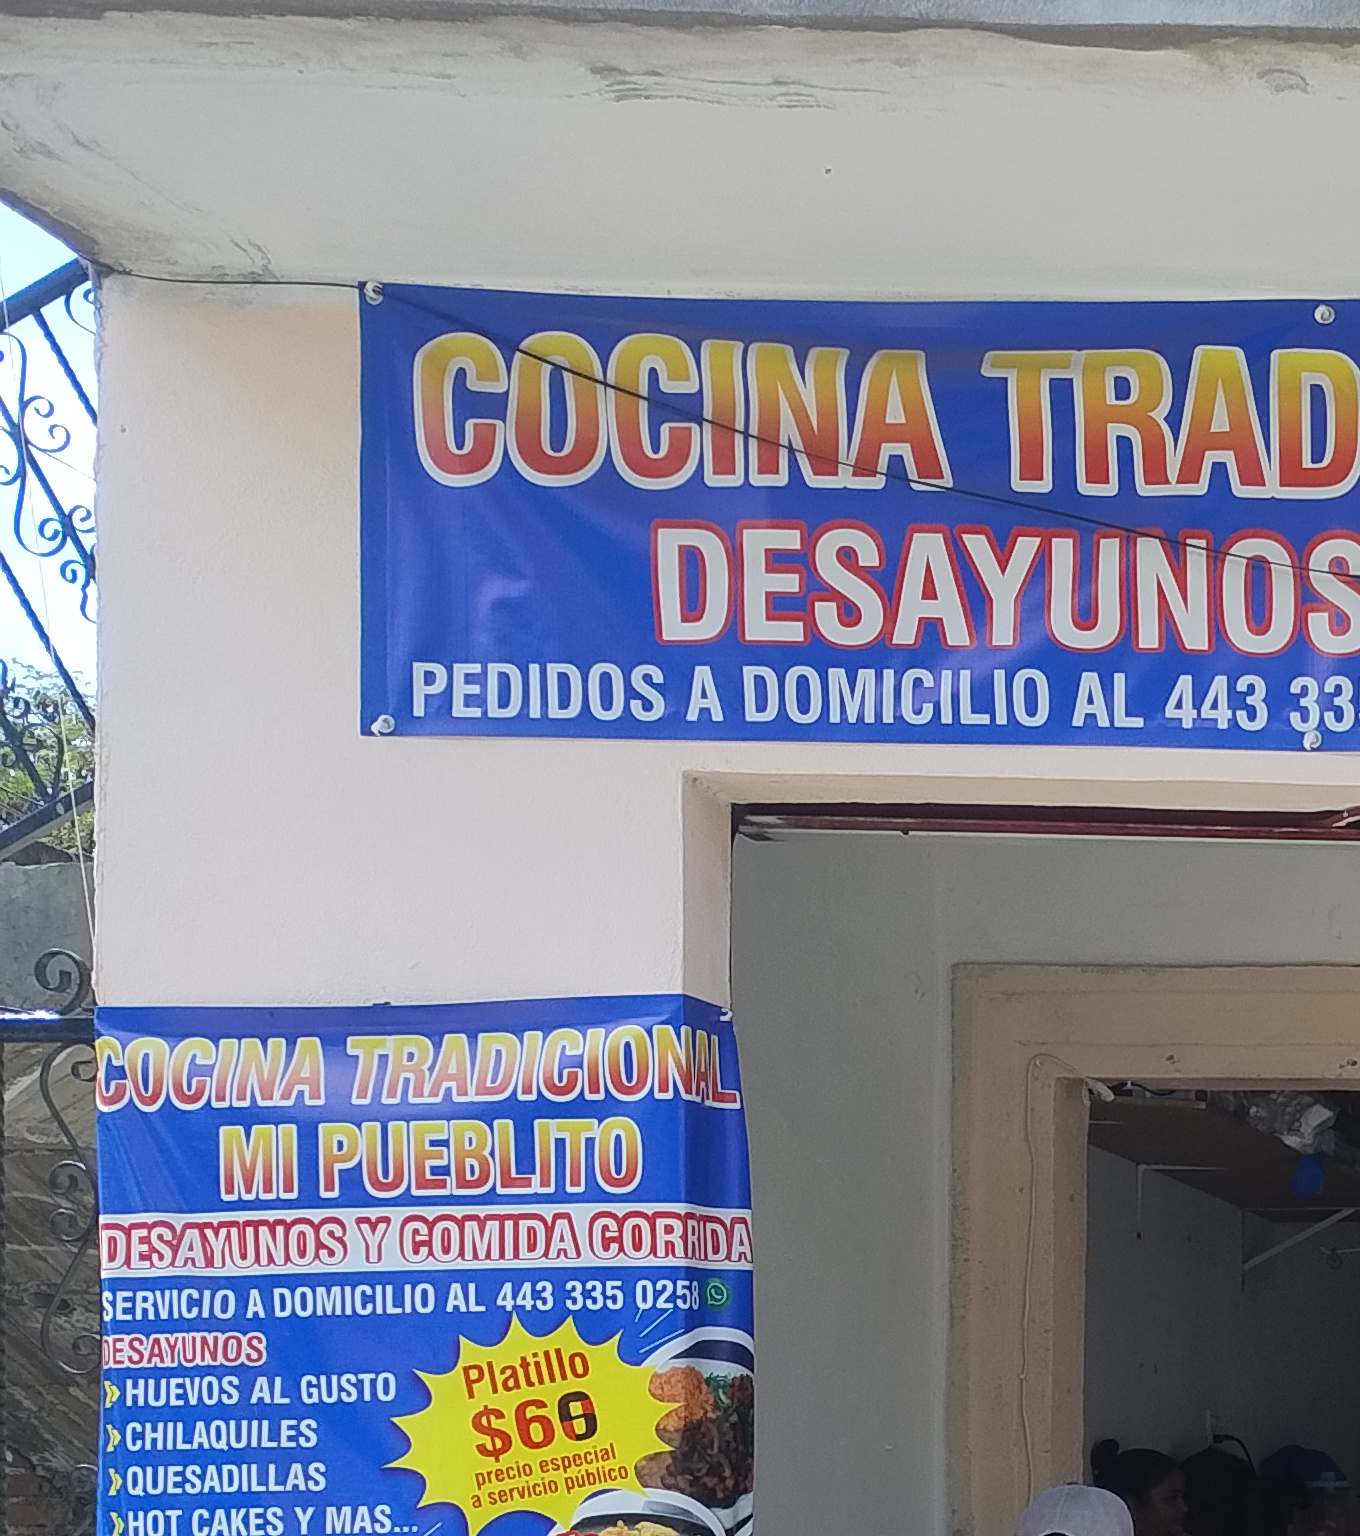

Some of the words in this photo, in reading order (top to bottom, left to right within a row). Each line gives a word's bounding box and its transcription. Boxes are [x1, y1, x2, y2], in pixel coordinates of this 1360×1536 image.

[414, 331, 953, 488] COCINA
[413, 662, 664, 721] PEDIDOS
[686, 666, 723, 721] A
[746, 666, 1049, 726] DOMICILIO
[1072, 672, 1144, 727] AL
[1165, 675, 1268, 730] 443
[96, 1036, 324, 1112] COCINA
[346, 1025, 740, 1109] TRADICIONAL
[219, 1124, 298, 1201] MI
[318, 1117, 642, 1198] PUEBLITO
[101, 1217, 348, 1268] DESAYUNOS
[355, 1216, 391, 1261] Y
[400, 1212, 581, 1260] COMIDA
[588, 1211, 749, 1261] CORRIDA
[102, 1289, 235, 1322] SERVICIO
[246, 1289, 265, 1318] A
[273, 1283, 435, 1317] DOMICILIO
[446, 1283, 485, 1312] AL
[497, 1281, 553, 1311] 443
[566, 1281, 623, 1310] 335
[633, 1277, 699, 1311] 0258
[102, 1330, 268, 1369] DESAYUNOS
[126, 1376, 239, 1406] HUEVOS
[250, 1377, 290, 1403] AL
[301, 1372, 396, 1404] GUSTO
[462, 1348, 590, 1400] Platillo
[126, 1420, 317, 1451] CHILAQUILES
[127, 1462, 326, 1496] QUESADILLAS
[471, 1493, 482, 1509] a
[488, 1477, 559, 1507] servicio
[565, 1465, 629, 1494] público
[474, 1461, 533, 1490] precio
[539, 1442, 617, 1474] especial
[294, 1507, 315, 1534] Y
[326, 1505, 418, 1534] MAS...
